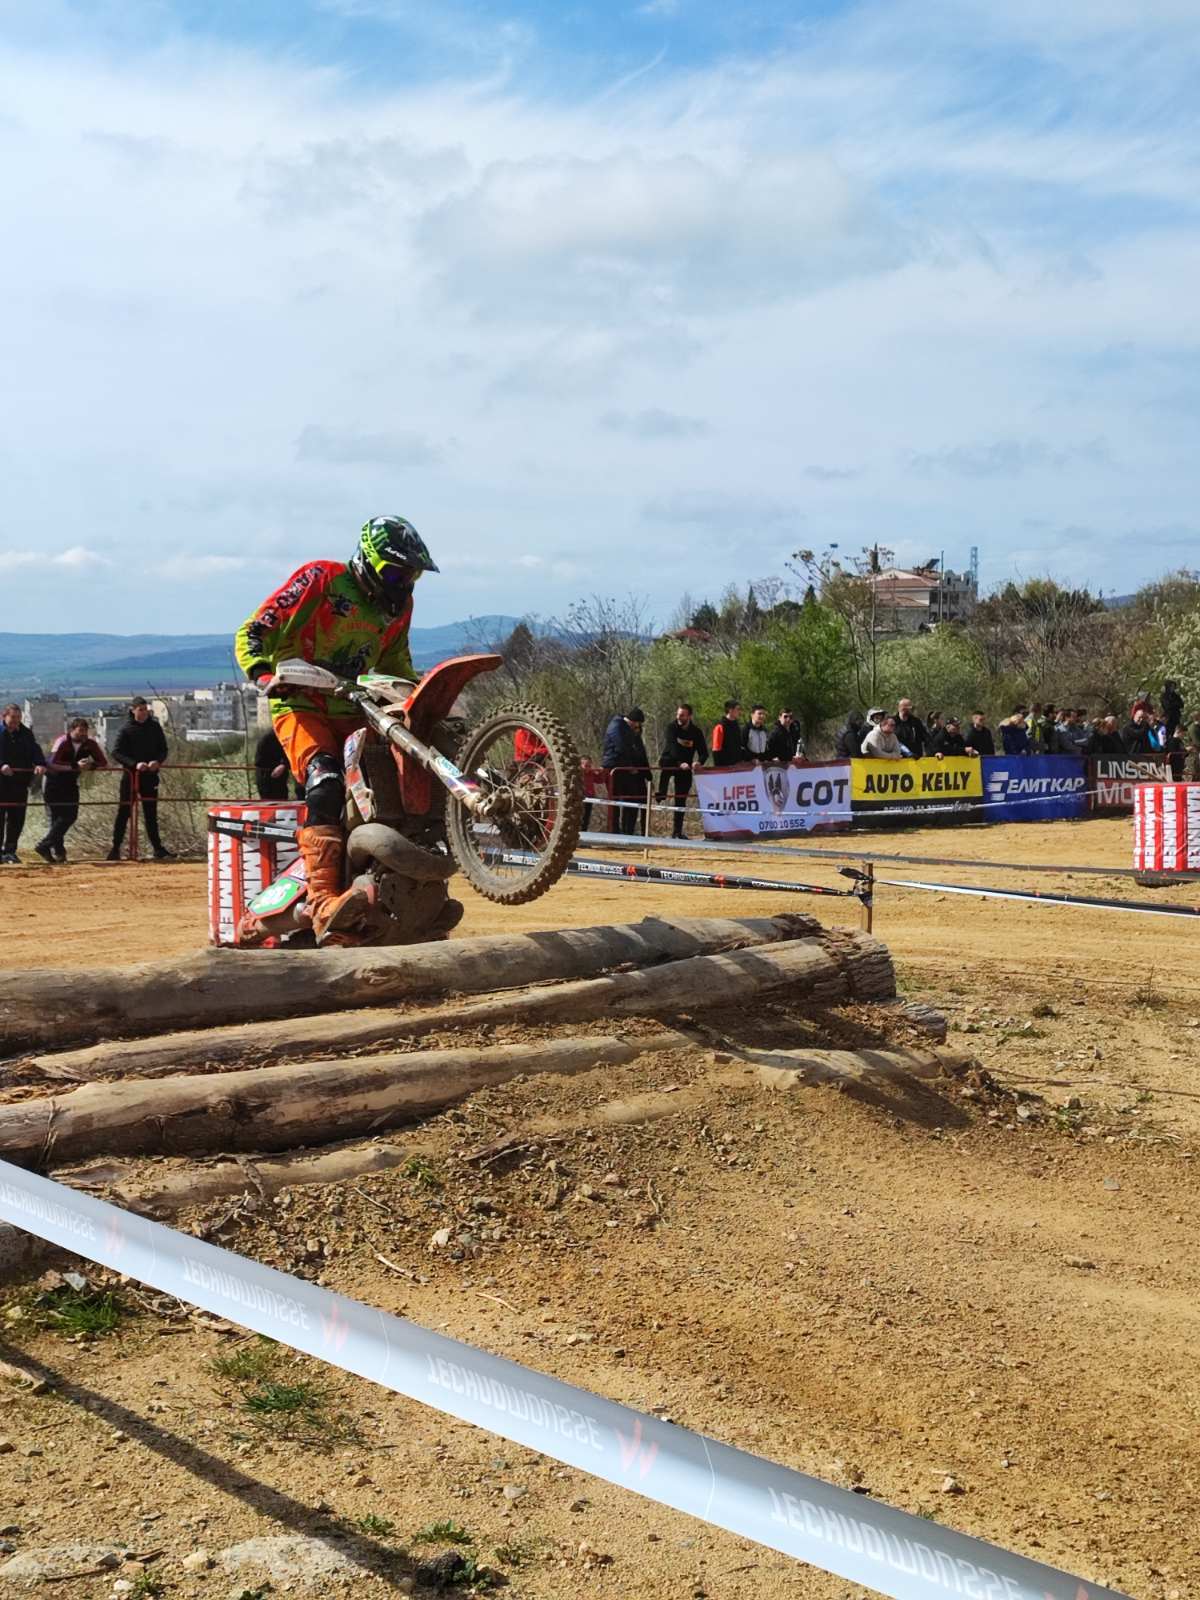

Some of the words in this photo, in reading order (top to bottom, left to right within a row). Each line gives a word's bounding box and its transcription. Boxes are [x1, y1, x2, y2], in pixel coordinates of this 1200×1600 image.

[863, 774, 914, 794] AUTO
[921, 771, 972, 792] KELLY
[723, 785, 757, 800] LIFE
